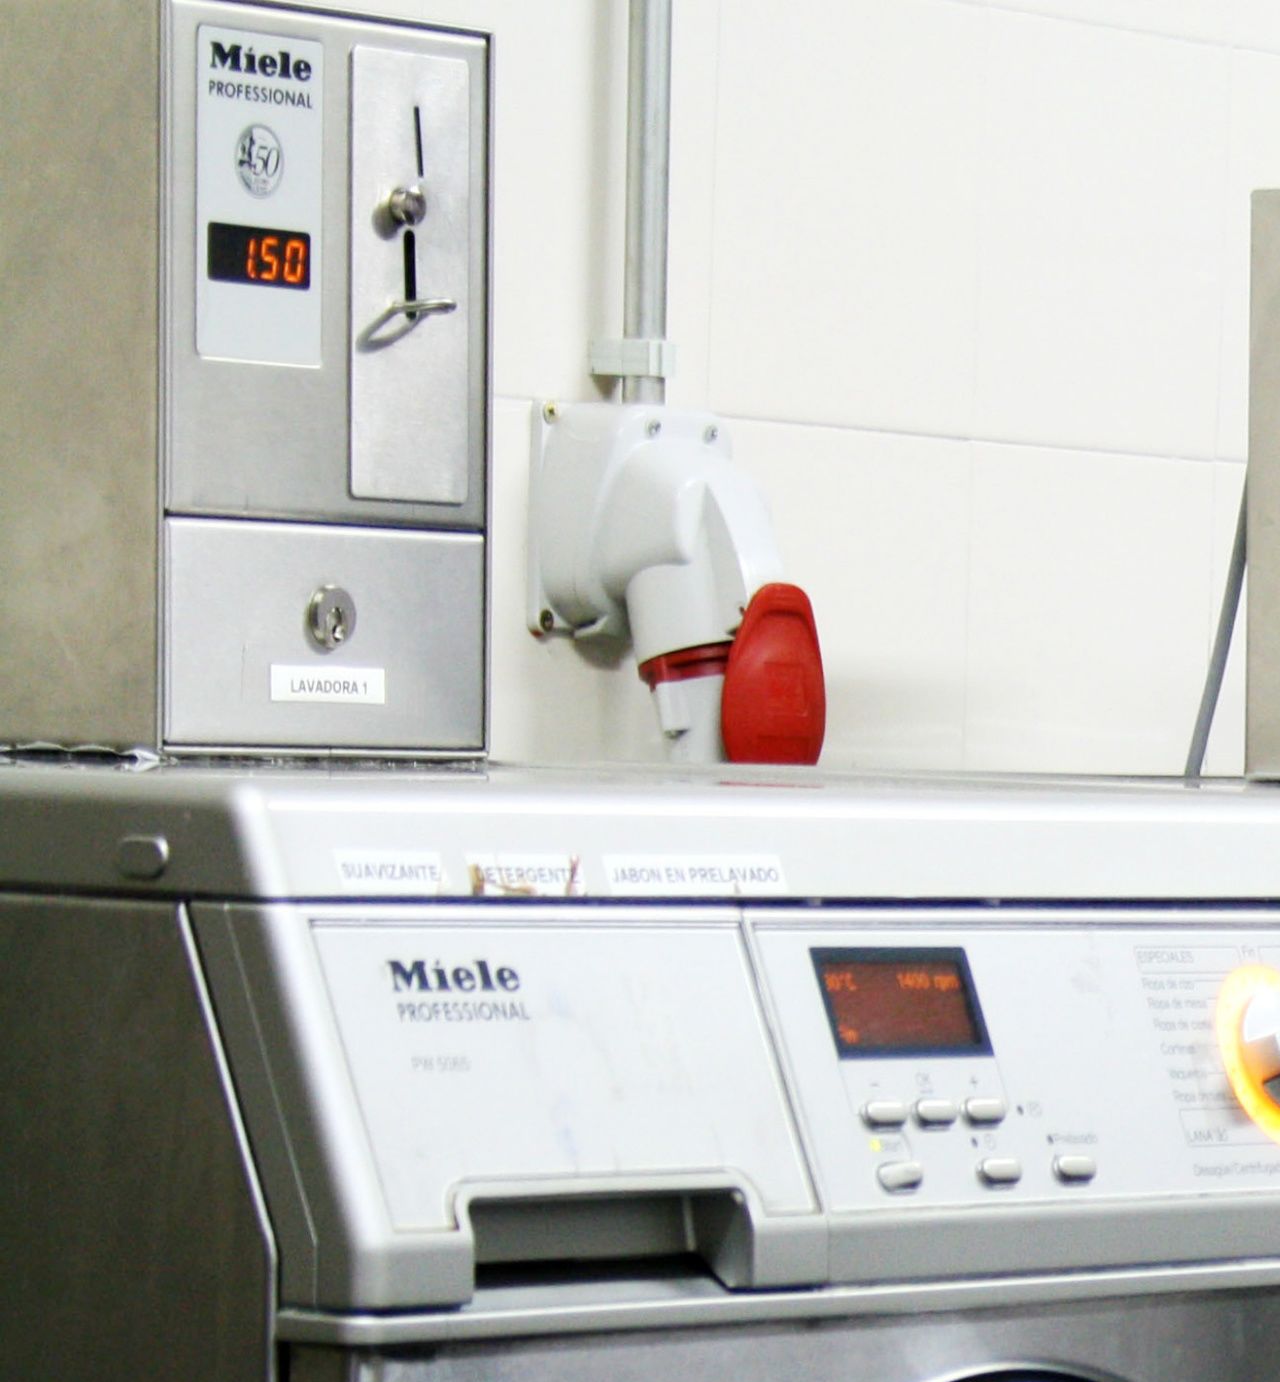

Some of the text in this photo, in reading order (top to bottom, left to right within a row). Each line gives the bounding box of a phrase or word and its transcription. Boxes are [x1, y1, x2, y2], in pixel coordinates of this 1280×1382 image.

[209, 41, 312, 82] Miele
[208, 80, 313, 109] PROFESSIONAL
[290, 679, 368, 695] LAVADORA 1
[341, 862, 440, 882] SUAVIZANTE
[612, 866, 779, 884] JABON EN PRELAVADO
[388, 958, 521, 993] Miele
[397, 1000, 531, 1022] PROFESSIONAL
